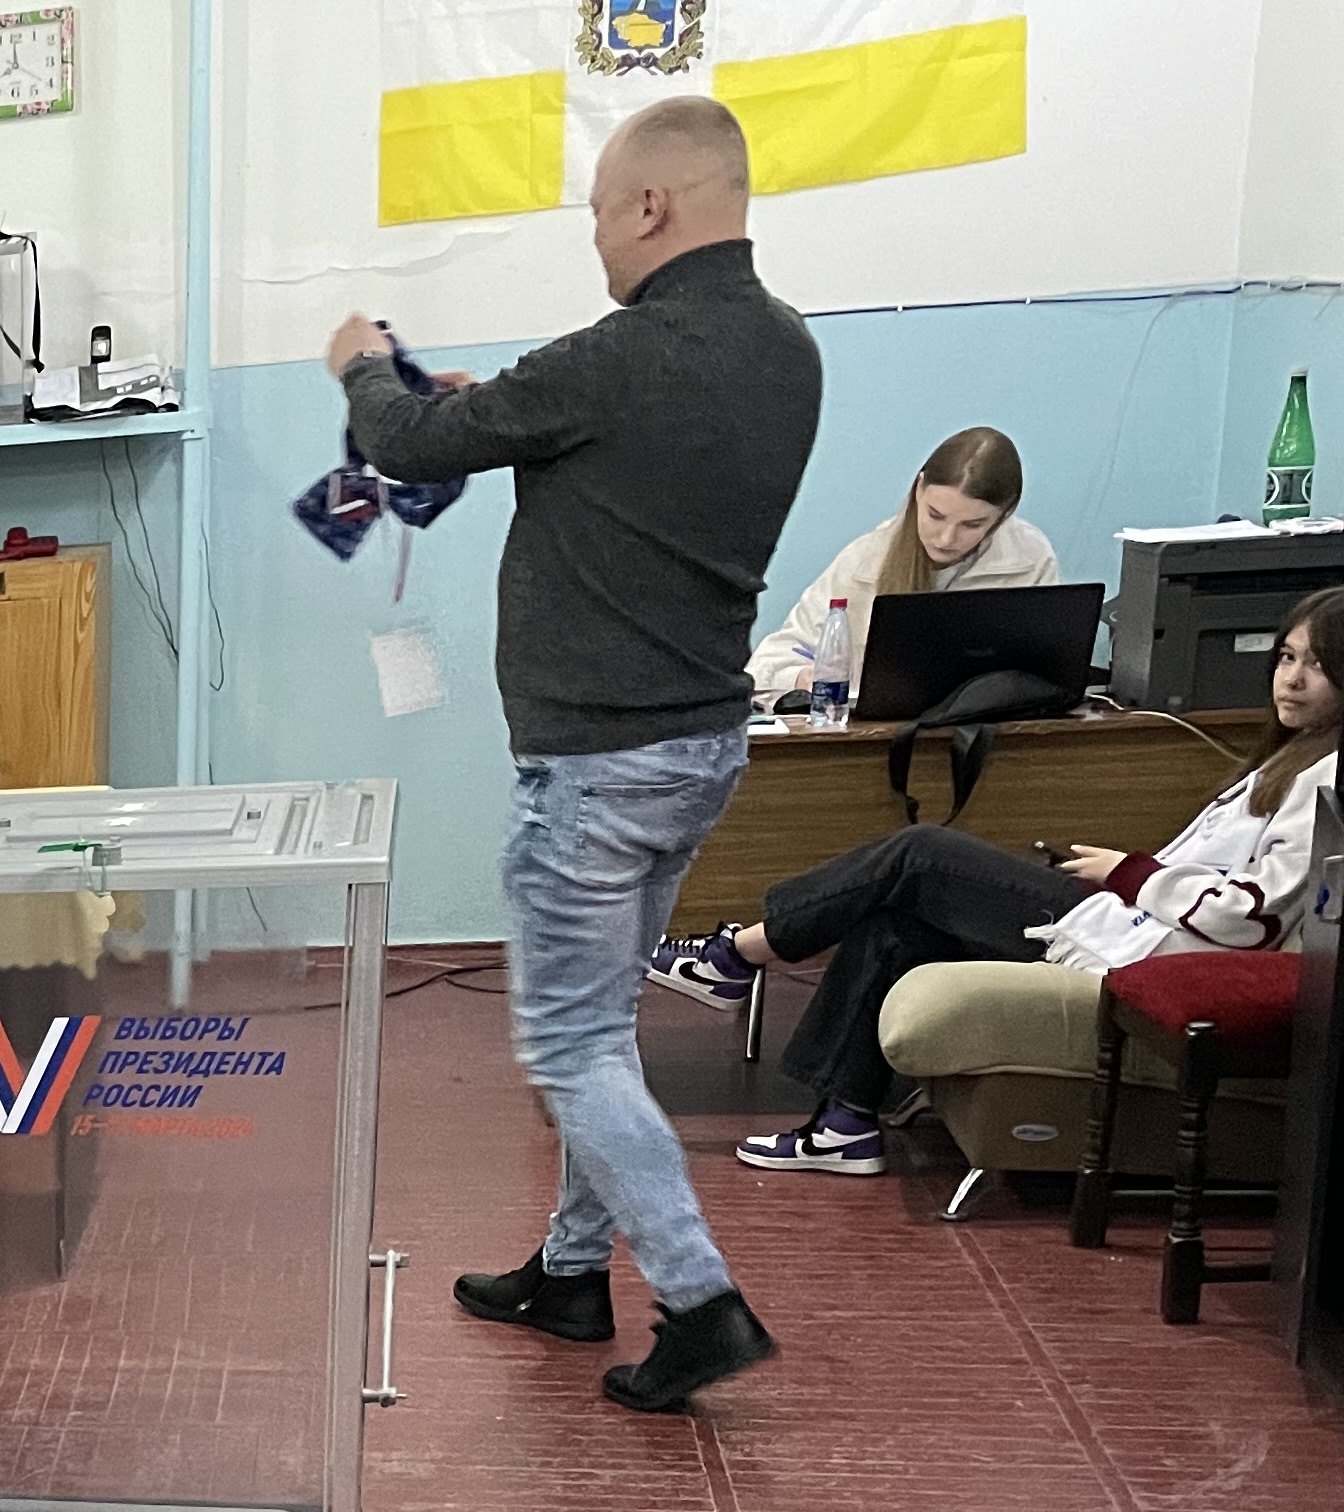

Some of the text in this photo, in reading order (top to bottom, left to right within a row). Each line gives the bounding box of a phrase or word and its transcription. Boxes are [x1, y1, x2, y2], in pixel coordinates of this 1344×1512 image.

[9, 33, 22, 44] 12
[32, 28, 36, 41] 1
[47, 34, 55, 46] 2
[45, 56, 55, 67] 3
[45, 77, 54, 88] 4
[11, 87, 20, 98] 6
[29, 84, 39, 97] 5
[113, 1017, 251, 1041] ВЫБОРЫ
[97, 1051, 287, 1078] ПРЕЗИДЕНТА
[83, 1084, 203, 1109] РОССИИ
